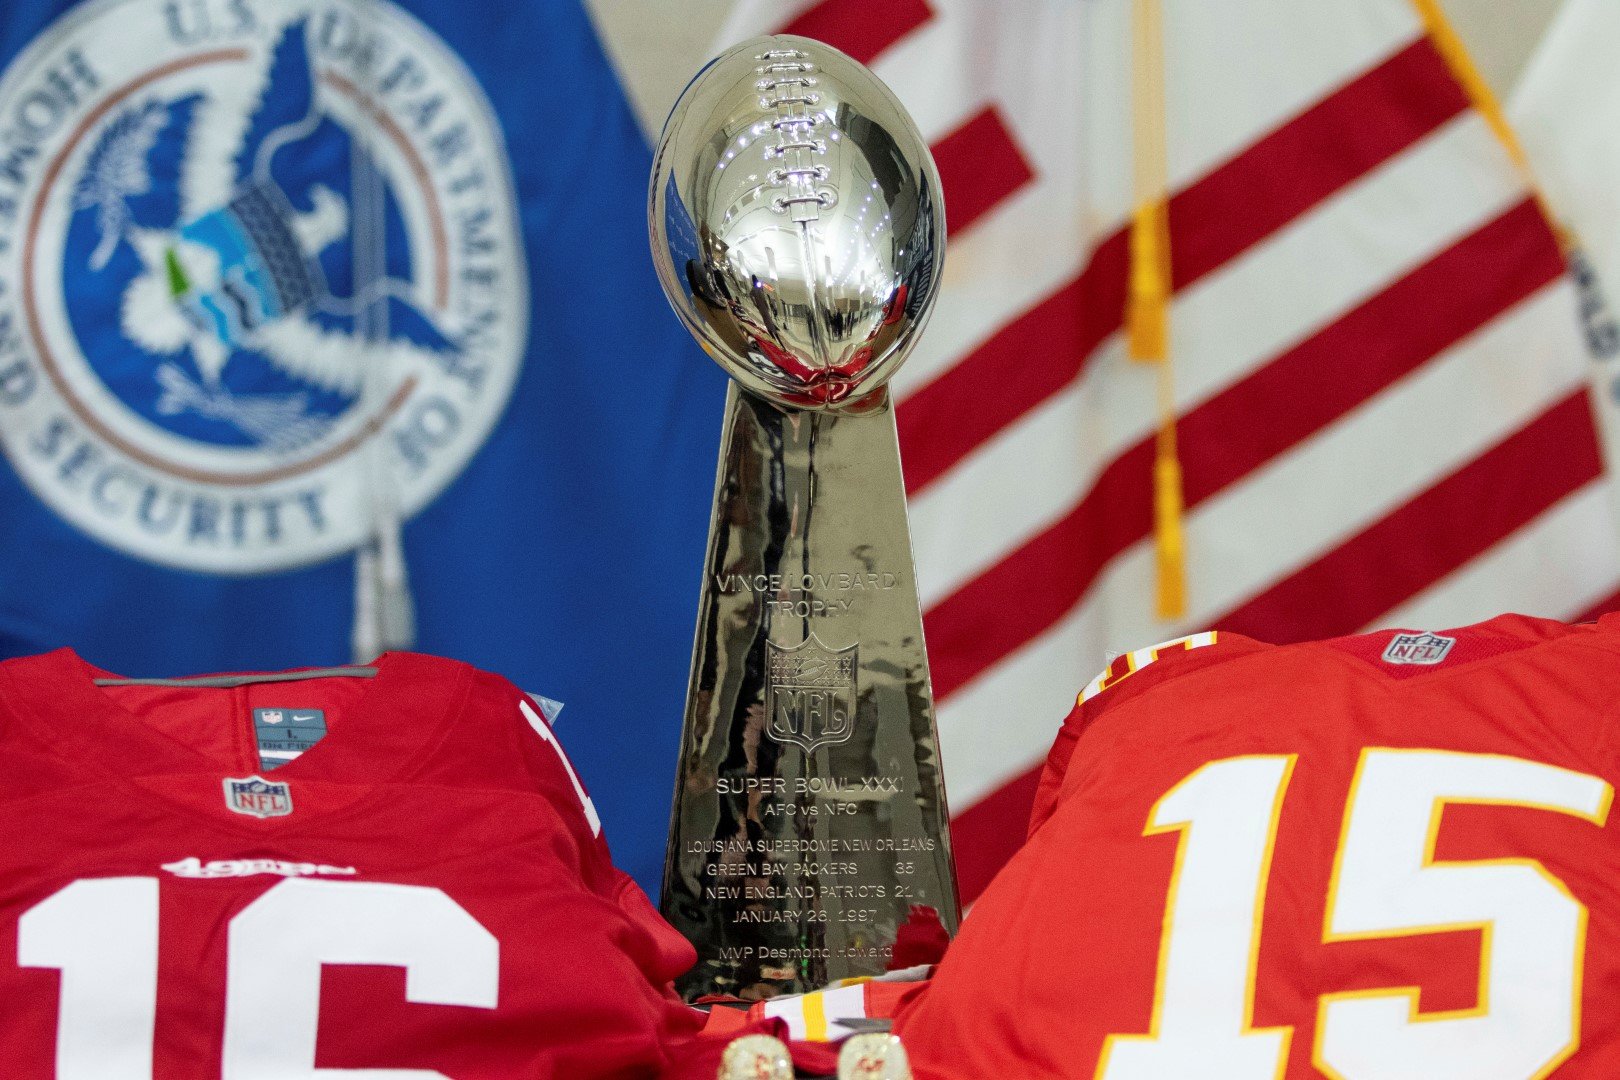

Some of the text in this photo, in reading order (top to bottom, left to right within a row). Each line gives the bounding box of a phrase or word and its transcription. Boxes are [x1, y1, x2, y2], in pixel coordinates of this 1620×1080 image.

[314, 6, 502, 394] DEPARTMENT
[28, 415, 327, 544] SECURITY
[716, 573, 781, 593] VINCE
[766, 600, 853, 618] TROPHY
[1394, 645, 1436, 660] NFL
[773, 689, 847, 741] NFL
[716, 777, 786, 794] SUPER
[795, 777, 855, 794] BOWL
[240, 792, 285, 812] NFL
[765, 803, 858, 816] AFC vs NFC
[687, 838, 935, 853] LOUISIANA SUPERDOME NEW ORLEANS
[707, 862, 915, 876] GREEN BAY PACKERS 35
[706, 885, 914, 899] NEW ENGLAND PATRIOTS 21
[733, 910, 803, 923] JANUARY
[838, 909, 878, 922] 1997
[1094, 746, 1615, 1080] 15
[719, 944, 894, 959] MVP Desmond Howard
[17, 877, 500, 1080] 16
